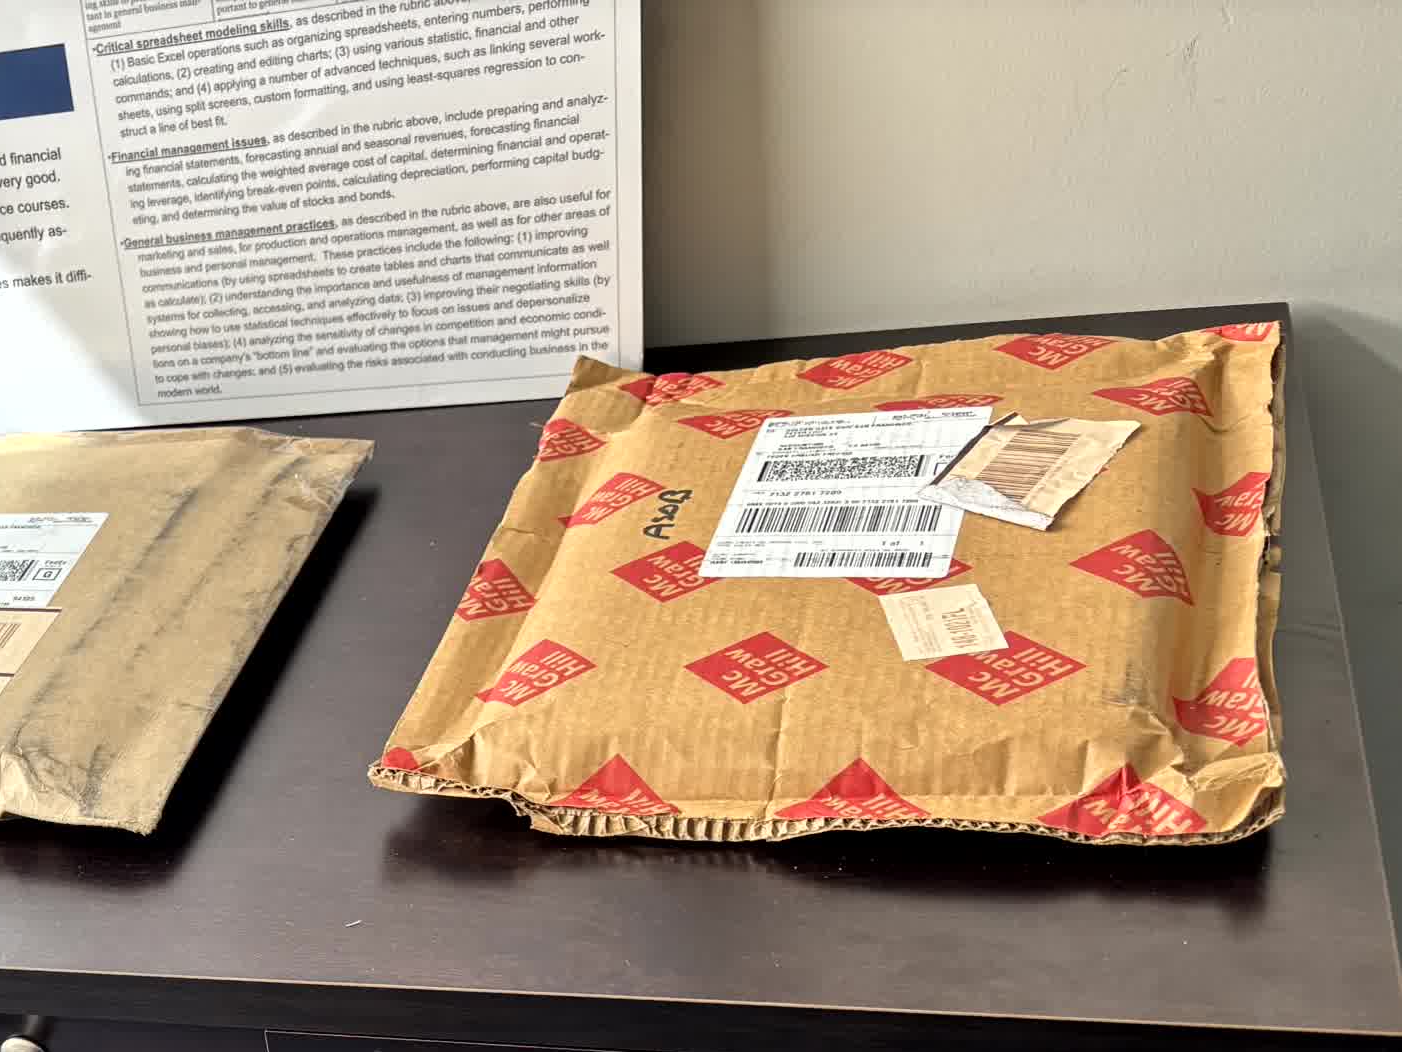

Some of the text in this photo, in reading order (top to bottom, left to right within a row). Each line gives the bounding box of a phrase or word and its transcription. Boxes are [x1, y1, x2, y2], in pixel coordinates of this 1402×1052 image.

[93, 38, 136, 57] Critical
[134, 29, 205, 52] spreadsheet
[203, 23, 260, 42] modeling
[258, 17, 293, 35] skills,
[295, 16, 309, 26] as
[310, 5, 363, 24] described
[365, 6, 376, 16] in
[378, 2, 397, 15] the
[398, 0, 431, 11] rubric
[112, 15, 579, 87] calculations, (2) creating and editing charts; (3) using various statistic, financial and other
[110, 93, 608, 164] Financial management issues, as described in the rubric above, include preparing and analyz-
[9, 146, 61, 164] financial
[16, 198, 69, 213] courses.
[122, 187, 611, 250] General business management practices, as described in the rubric above, are also useful for
[11, 274, 52, 287] makes
[54, 271, 63, 284] it
[65, 268, 91, 283] diffi-
[648, 555, 705, 587] Graw
[1112, 564, 1160, 591] Mc
[643, 574, 684, 597] Mc
[540, 650, 587, 676] Hill
[725, 648, 789, 686] Graw
[764, 648, 817, 676] Hill
[1013, 647, 1074, 676] Hill
[498, 680, 537, 700] Mc
[722, 670, 766, 697] Mc
[967, 671, 1021, 698] Mc
